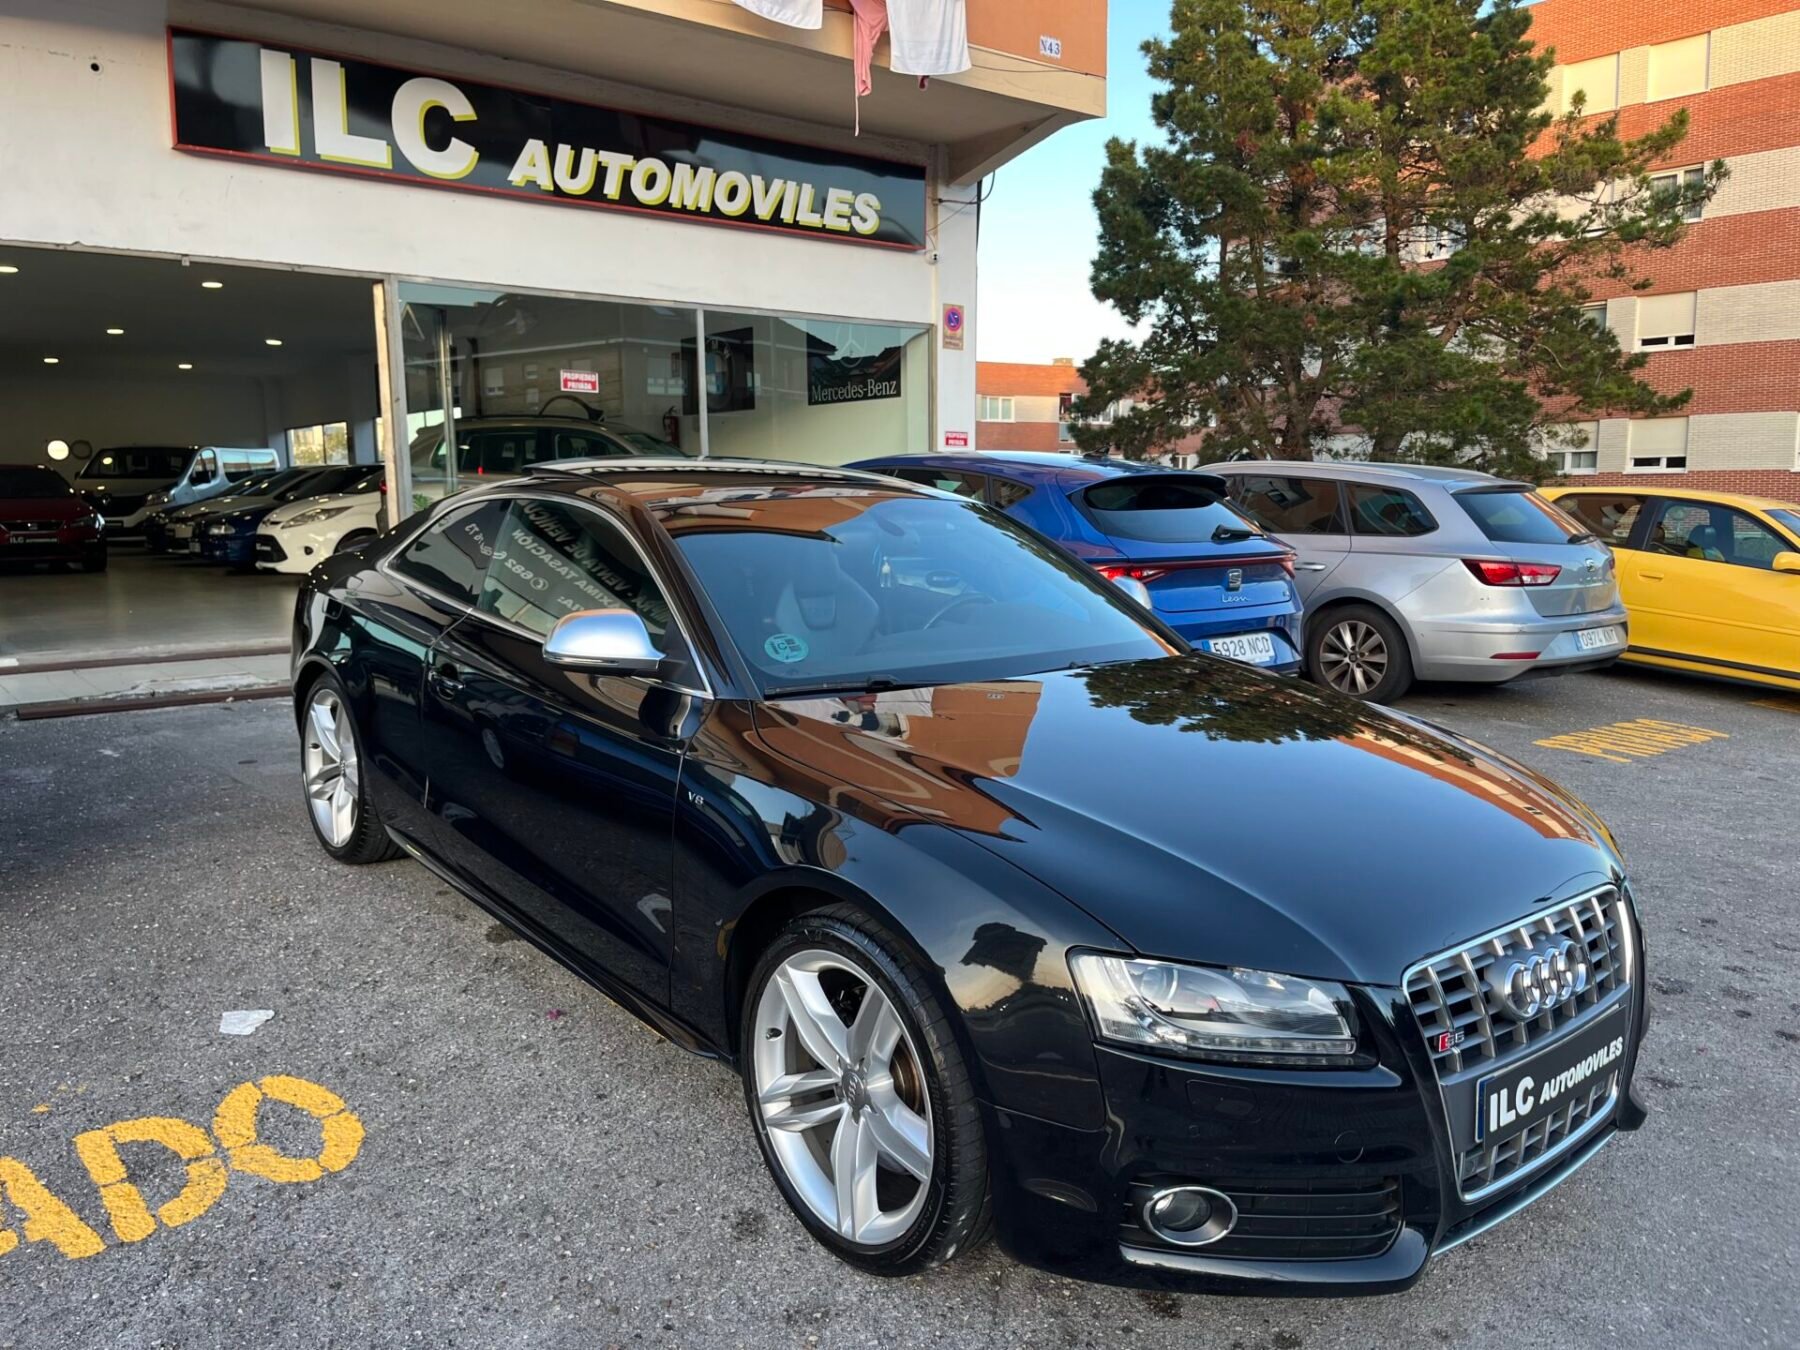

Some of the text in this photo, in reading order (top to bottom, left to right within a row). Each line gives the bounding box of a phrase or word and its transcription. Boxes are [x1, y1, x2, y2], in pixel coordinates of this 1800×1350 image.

[260, 48, 881, 235] ILC AUTOMOVILES
[811, 378, 897, 402] Mercedes-Benz
[1221, 593, 1248, 603] Leon
[1213, 636, 1272, 657] 5928 NCD
[688, 791, 704, 805] V8
[1489, 1036, 1624, 1133] ILC AUTOMOVILES
